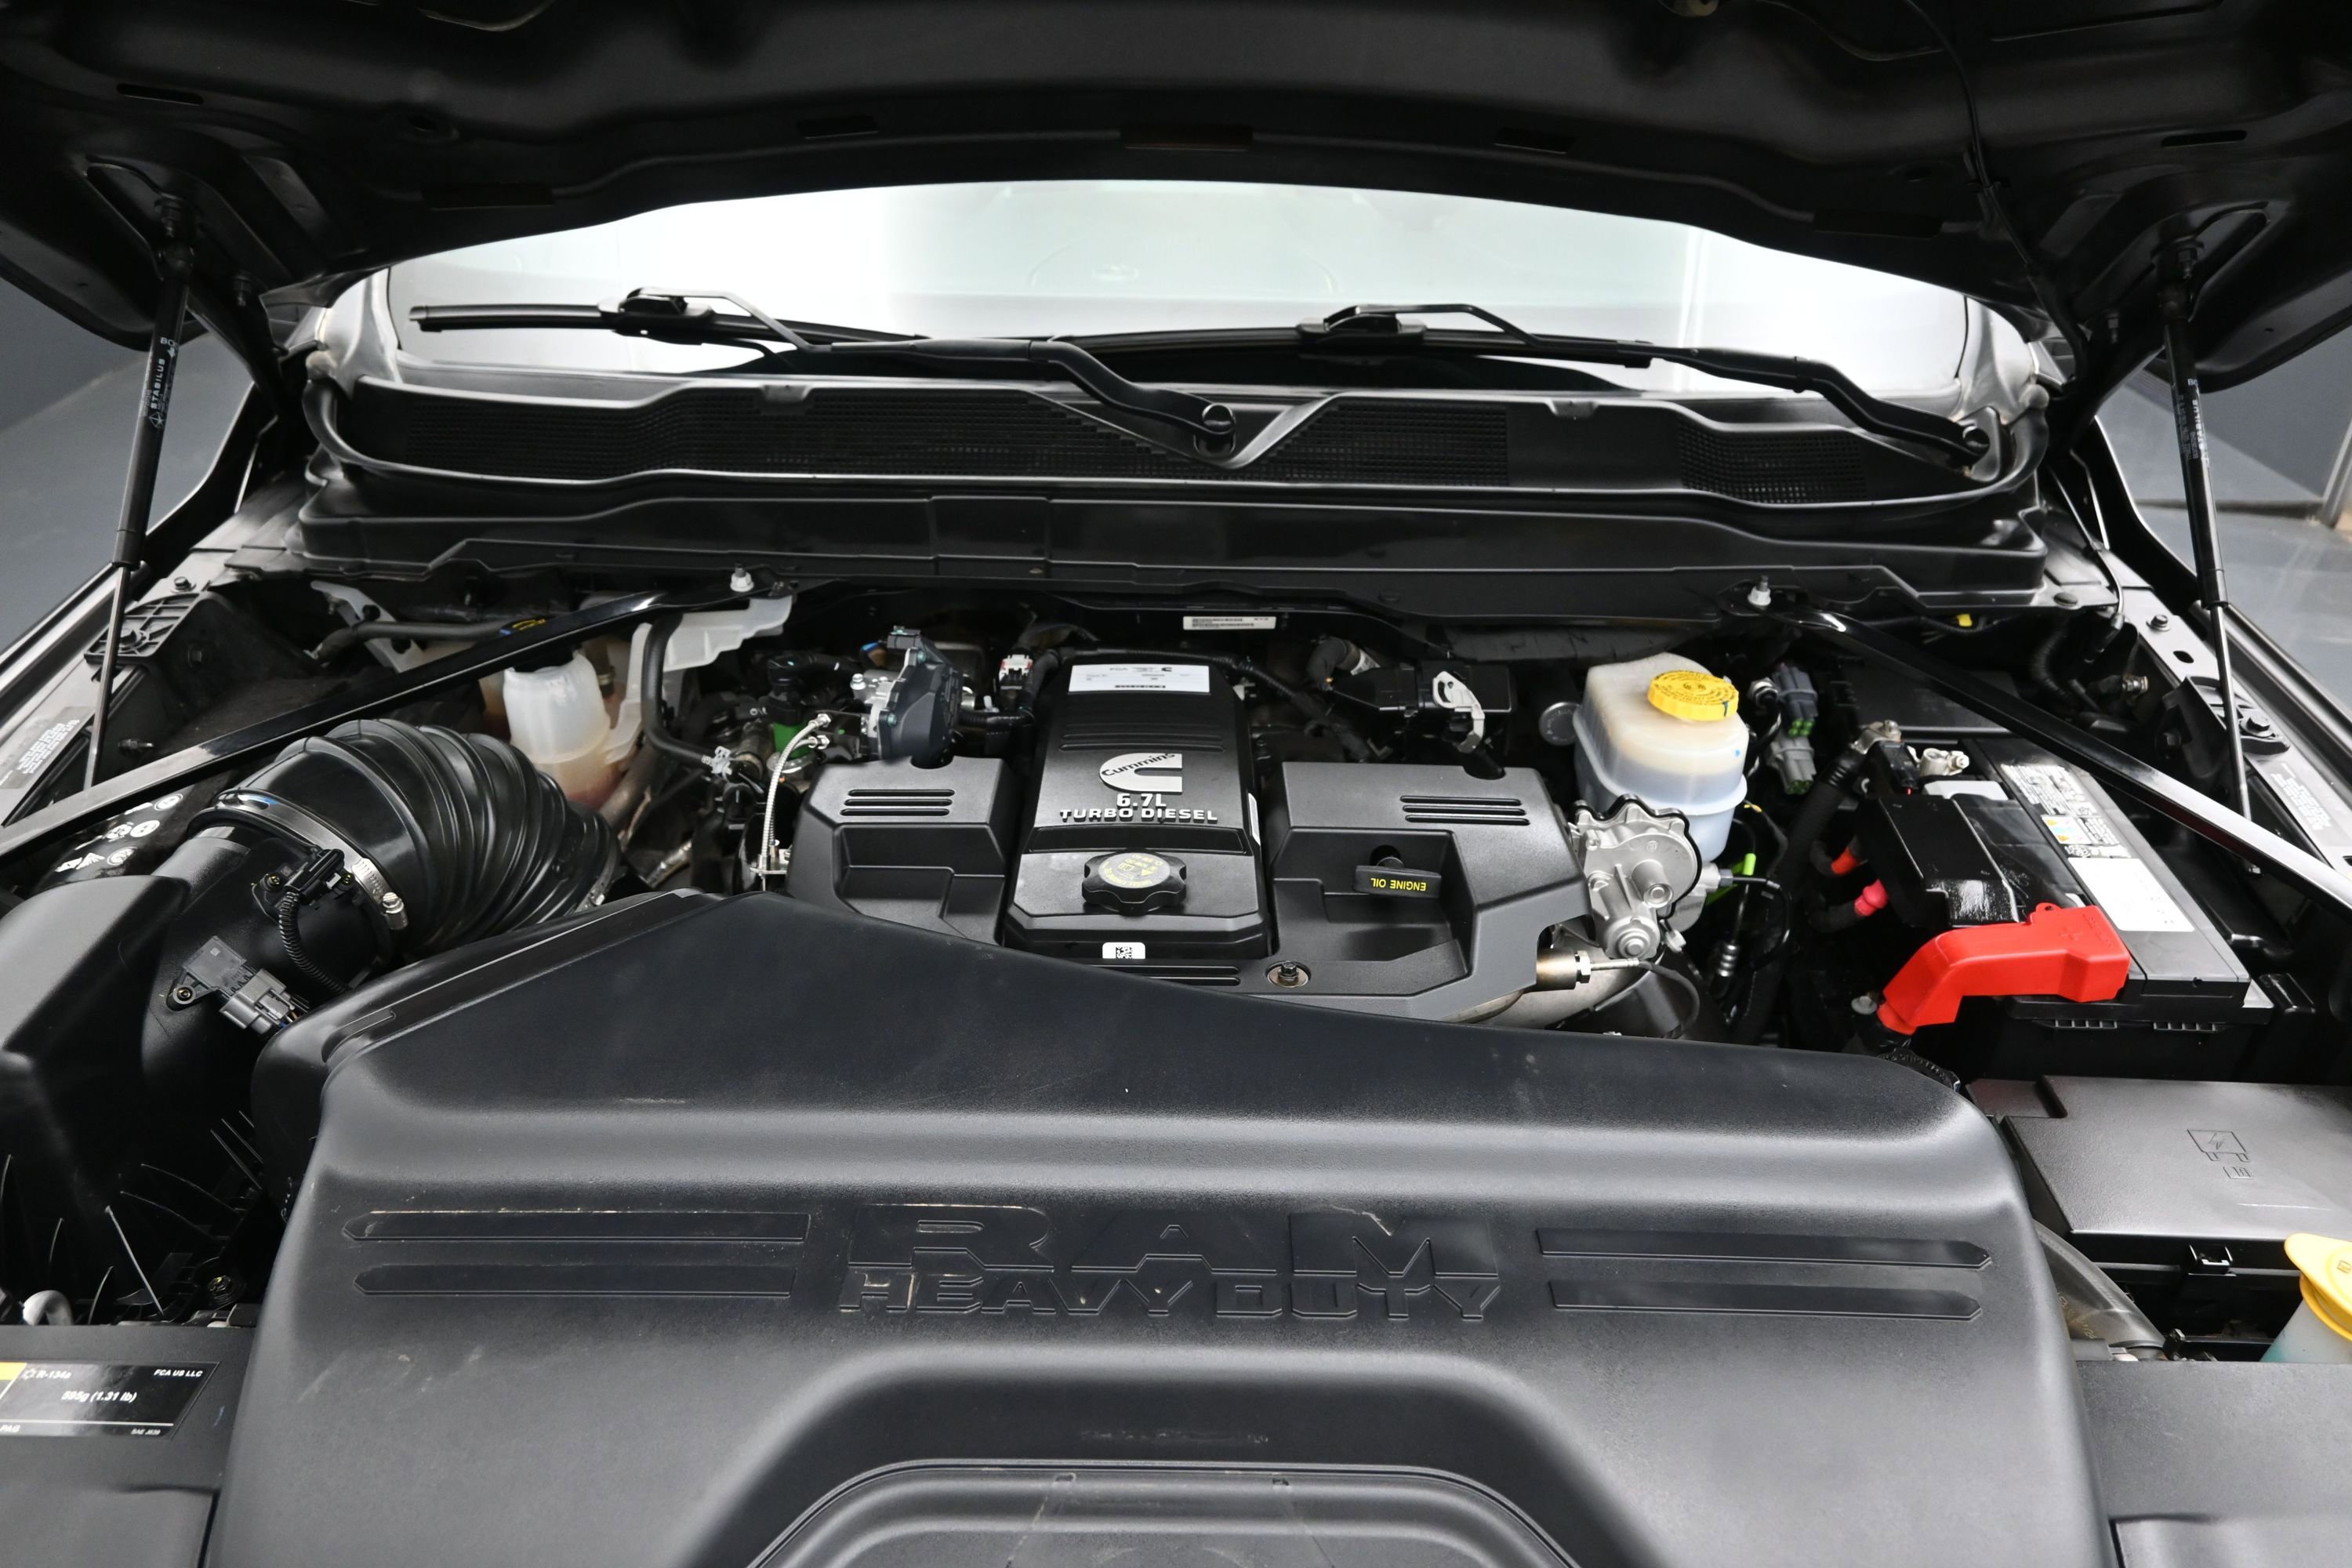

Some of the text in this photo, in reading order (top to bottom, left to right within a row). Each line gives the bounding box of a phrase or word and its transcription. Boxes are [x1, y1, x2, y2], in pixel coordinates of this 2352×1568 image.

[151, 358, 165, 409] STABILUS
[1102, 753, 1175, 776] Cummins
[1116, 793, 1167, 808] 6.7L
[1060, 808, 1218, 821] TURBO DIESEL
[1370, 878, 1427, 891] ENGINE OIL
[848, 1203, 1500, 1278] RAM
[839, 1271, 1502, 1320] HEAVY DUTY
[89, 1391, 120, 1403] (1.31
[120, 1392, 137, 1403] lb)
